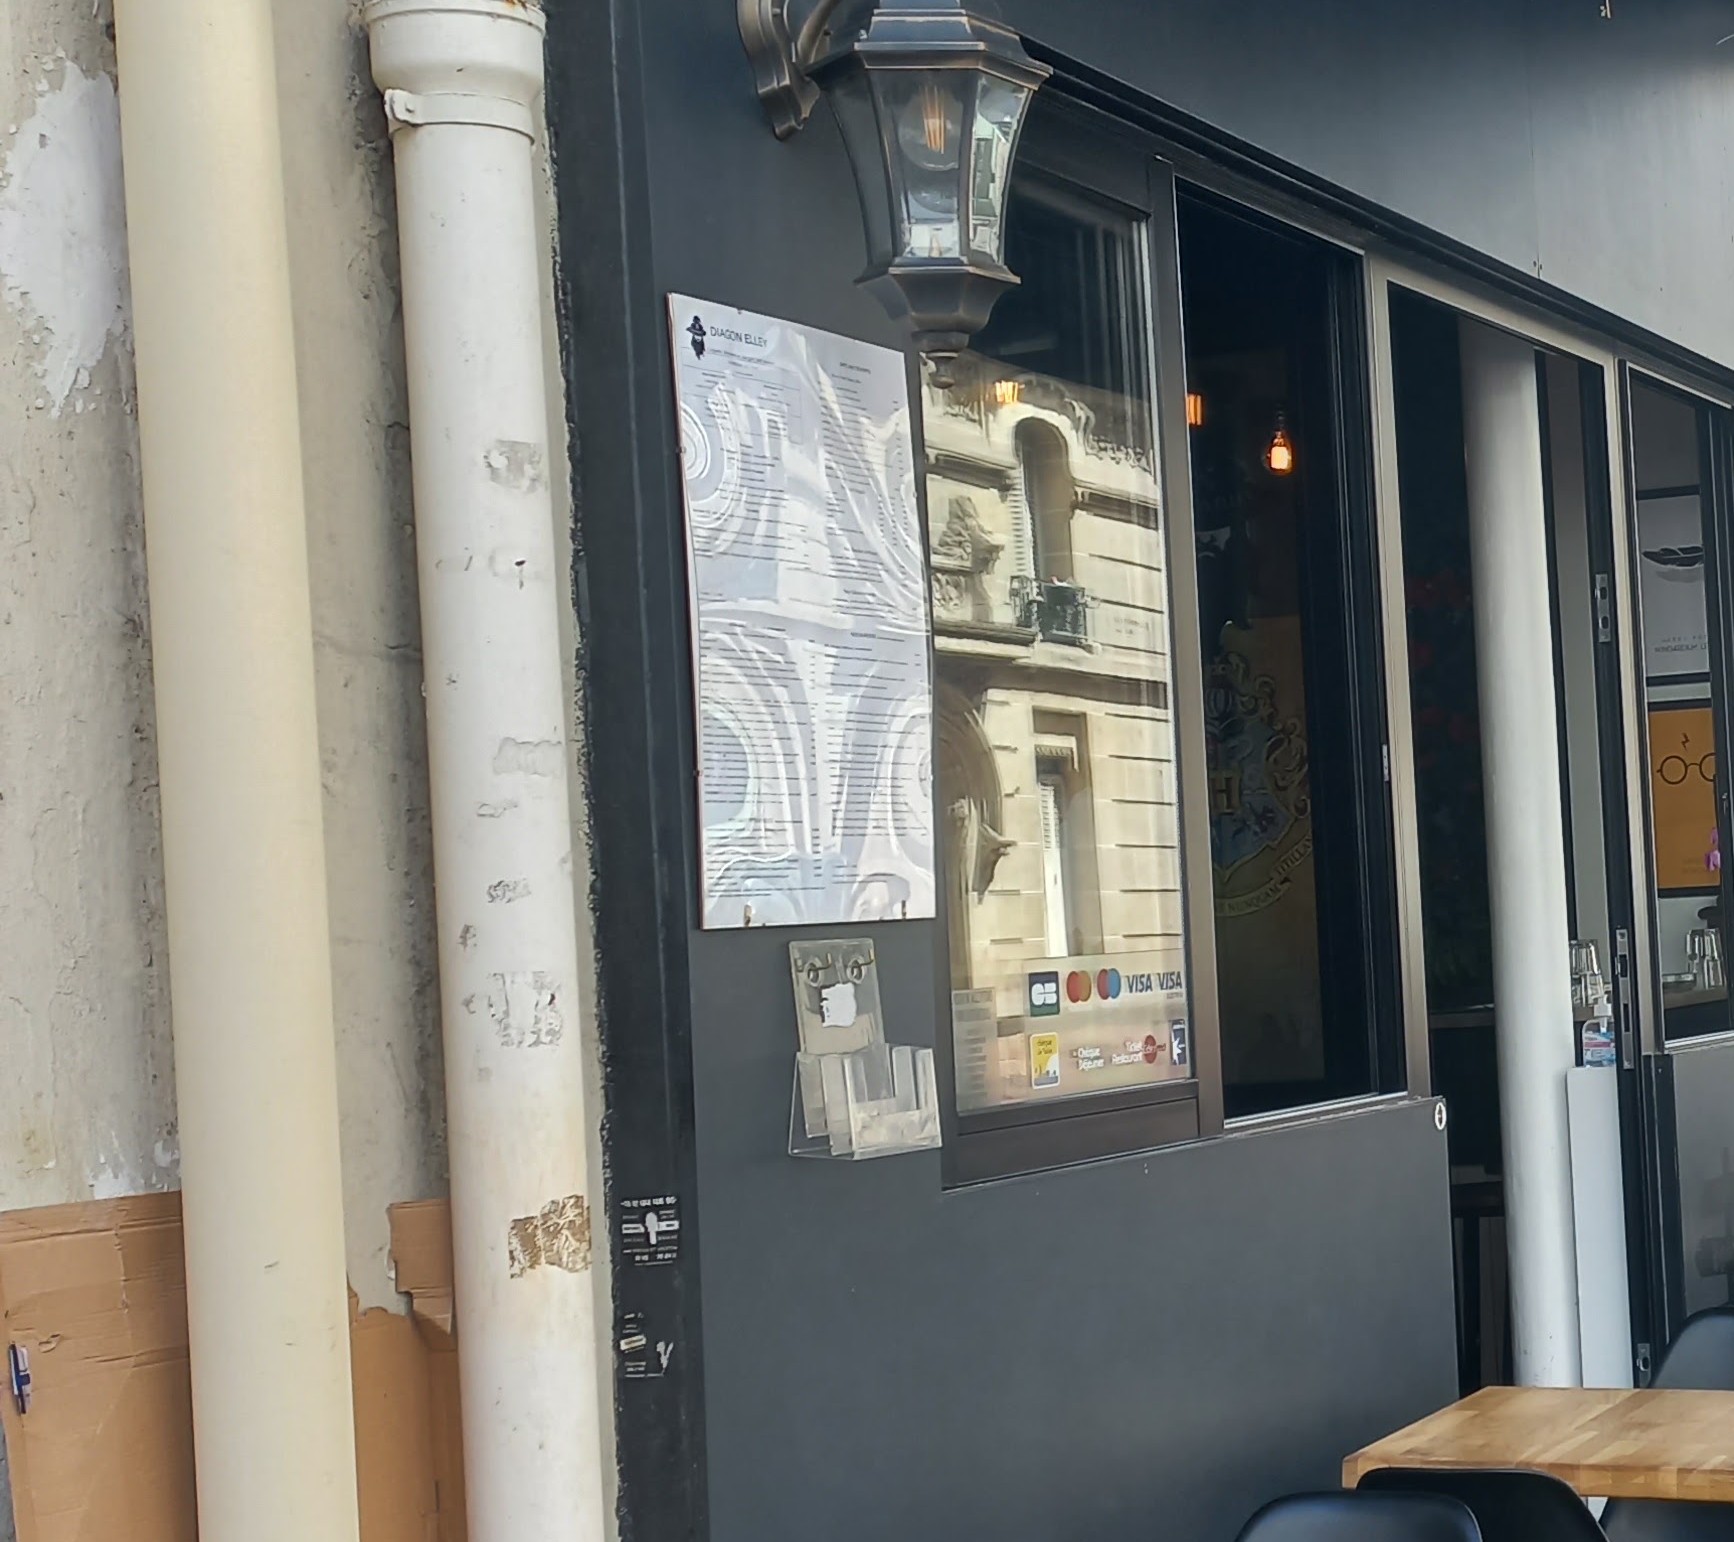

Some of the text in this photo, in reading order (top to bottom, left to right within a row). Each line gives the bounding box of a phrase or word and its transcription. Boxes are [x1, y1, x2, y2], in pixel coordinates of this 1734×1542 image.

[710, 326, 768, 348] DIAGON ELLEY
[1125, 973, 1153, 994] VISA
[1156, 971, 1183, 991] VISA
